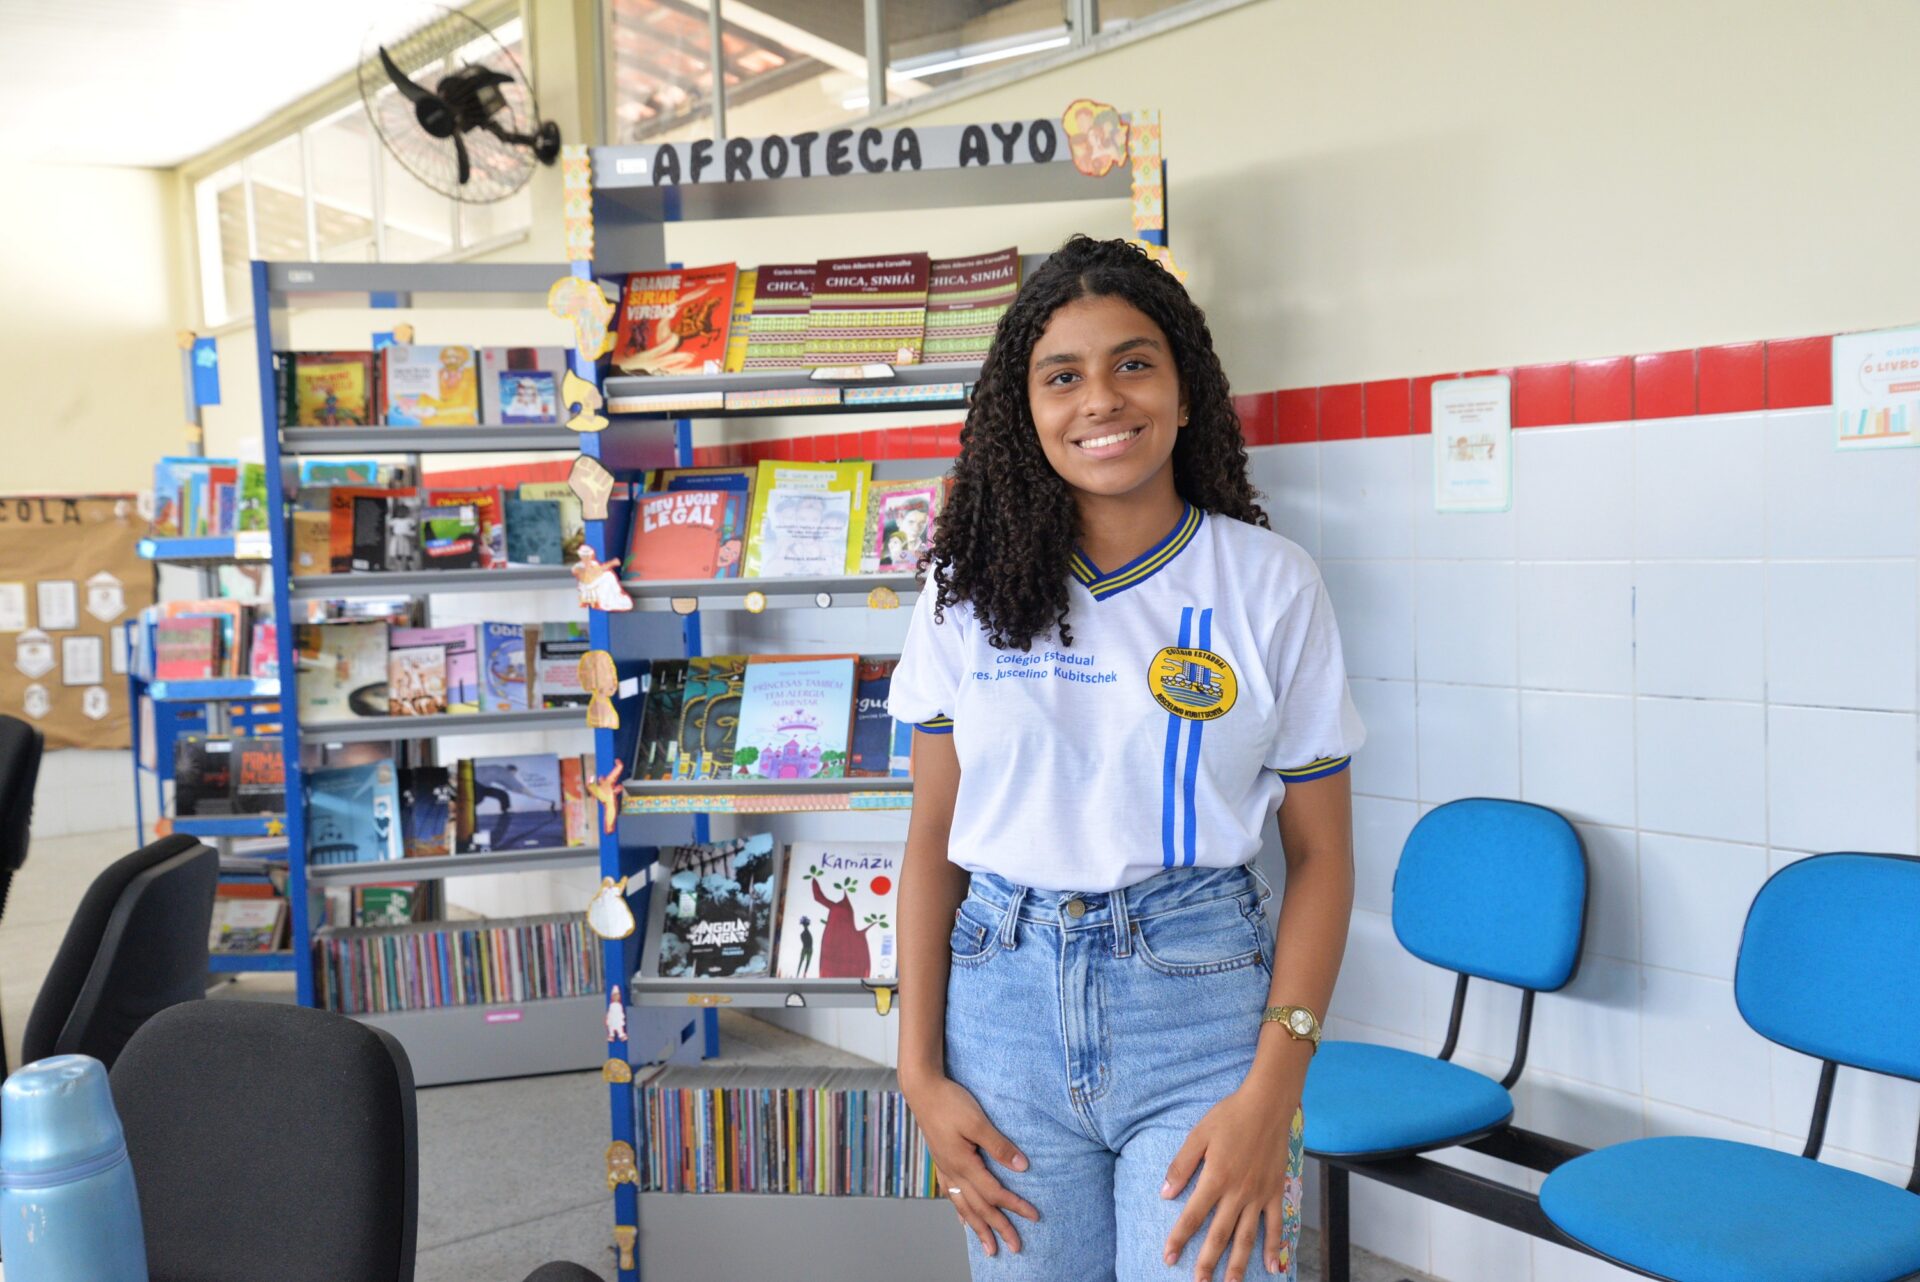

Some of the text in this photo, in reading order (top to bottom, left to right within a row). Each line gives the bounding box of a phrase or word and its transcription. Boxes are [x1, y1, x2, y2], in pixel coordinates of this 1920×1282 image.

[652, 118, 1058, 187] AFROTECA AYO
[774, 268, 792, 276] Carlos
[826, 276, 868, 288] CHICA,
[870, 272, 915, 286] SINHÁ!
[971, 265, 1013, 283] SINHÁ!
[631, 275, 682, 291] GRANDE
[766, 281, 809, 291] CHICA,
[643, 492, 719, 517] MEU LUGAR
[644, 505, 715, 534] LEGAL
[996, 651, 1095, 667] Colégio Estadual
[971, 666, 1118, 684] res. Juscelino Kubitschek
[753, 680, 802, 693] PRINCESAS
[787, 689, 825, 698] ALERGIA
[692, 918, 747, 934] ANGOLA
[691, 931, 741, 947] JANGA
